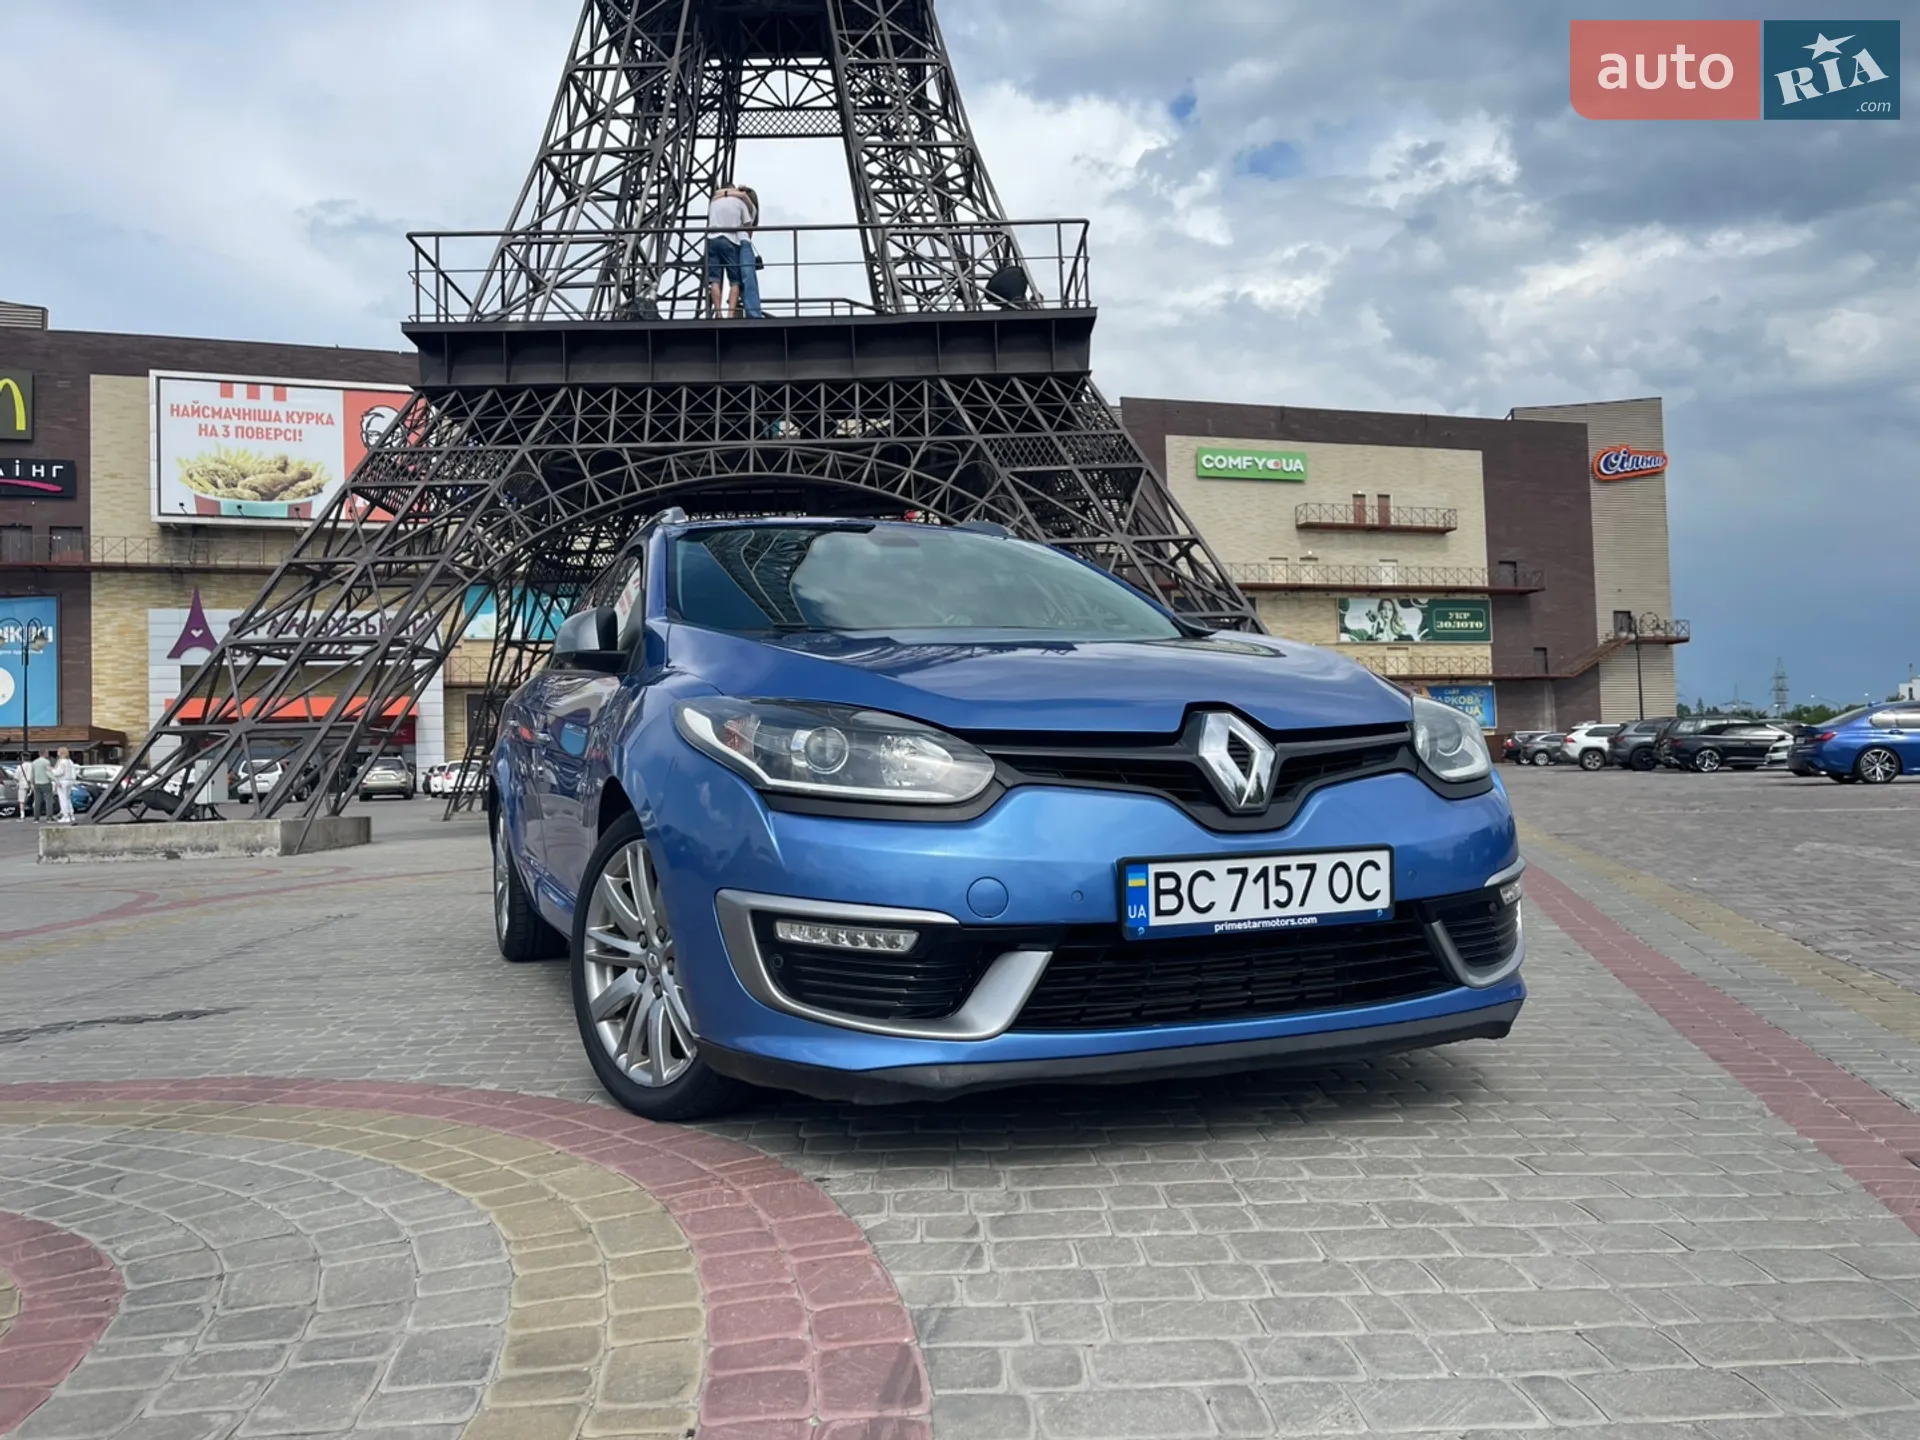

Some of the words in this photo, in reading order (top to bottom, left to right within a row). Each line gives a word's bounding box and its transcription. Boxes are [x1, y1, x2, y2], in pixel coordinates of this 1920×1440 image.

[170, 400, 282, 423] НАЙСМАЧНІША
[285, 410, 335, 426] КУРКА
[198, 423, 218, 438] НА
[222, 424, 231, 438] 3
[235, 425, 303, 442] ПОВЕРСІ!
[1436, 621, 1483, 629] ЗОЛОТО
[1153, 869, 1216, 917] BC
[1226, 862, 1317, 913] 7157
[1127, 905, 1147, 919] UA
[1214, 915, 1318, 933] primestarmotors.com
